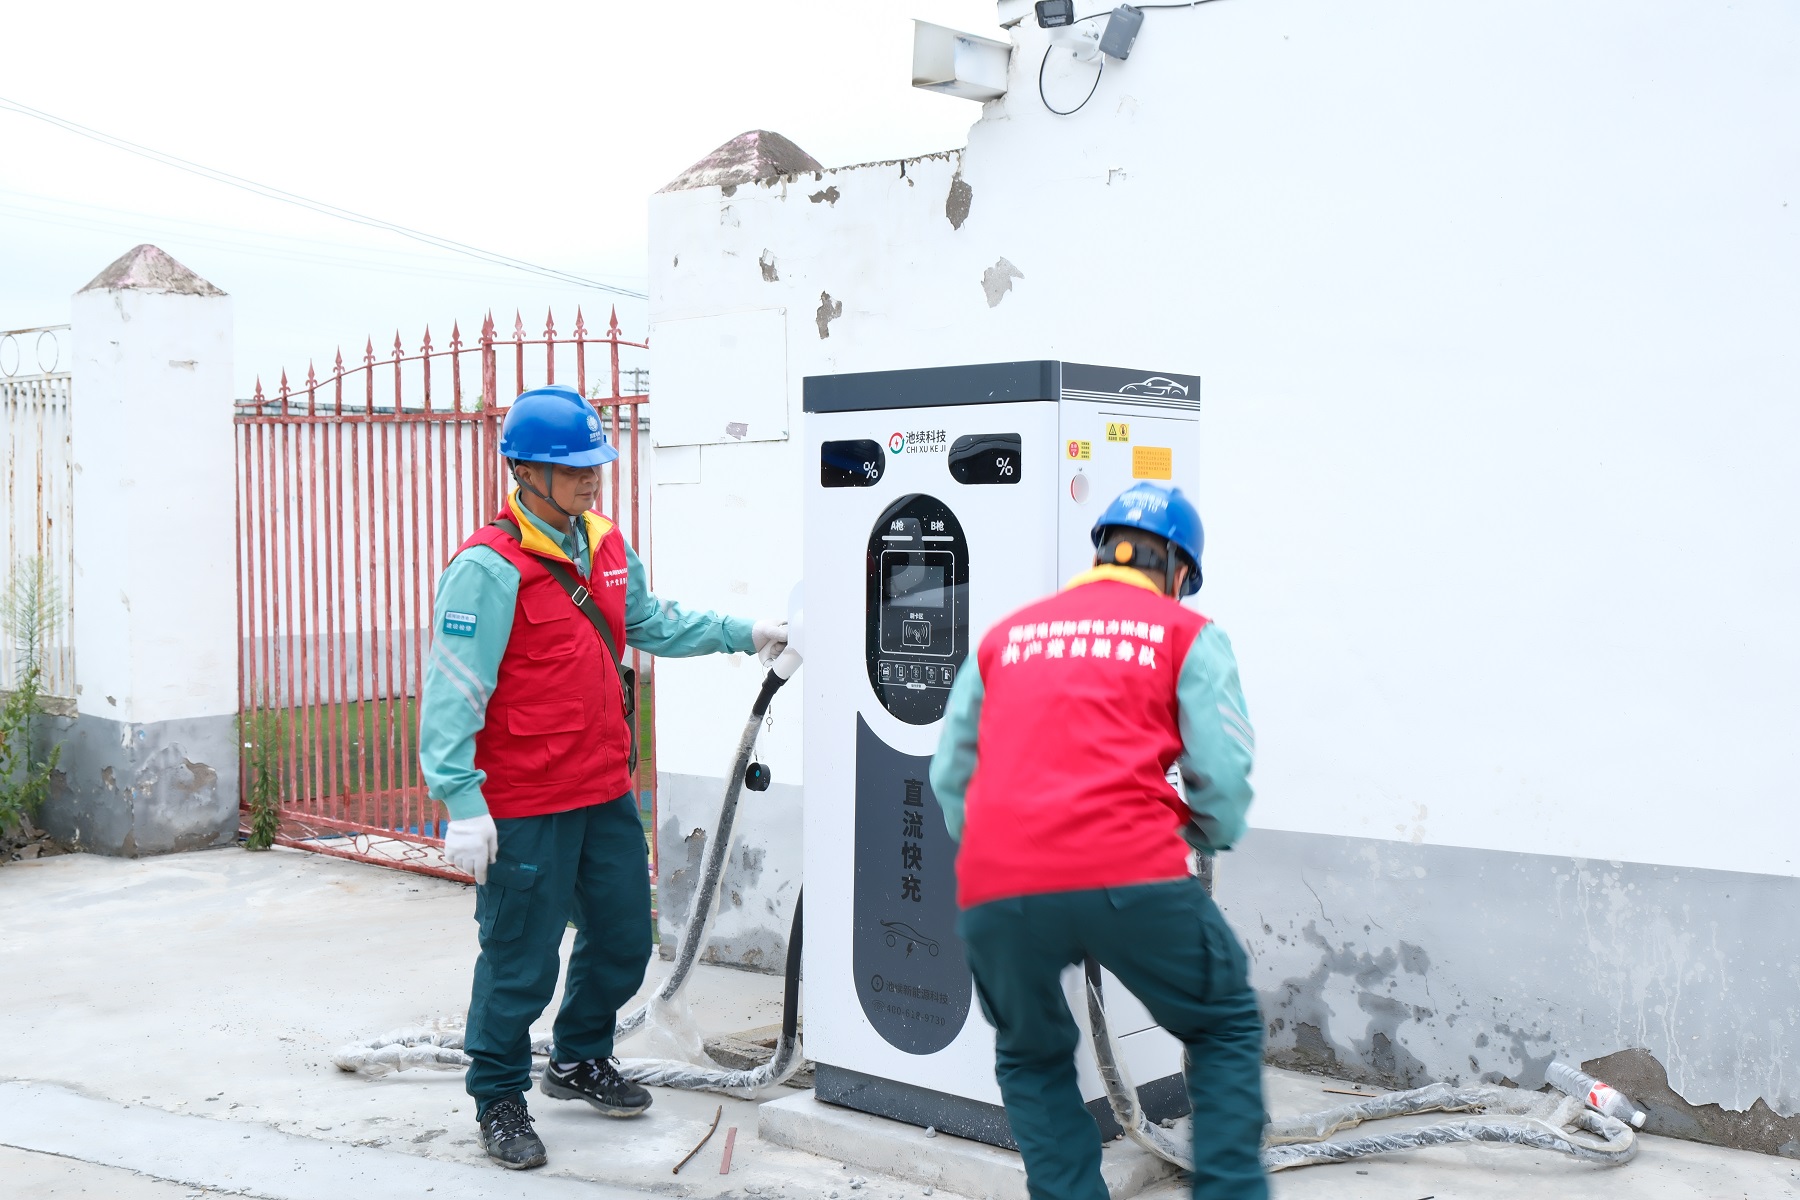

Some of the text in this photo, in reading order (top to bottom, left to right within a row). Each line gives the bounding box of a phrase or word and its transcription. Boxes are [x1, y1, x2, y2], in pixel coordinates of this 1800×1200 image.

[905, 429, 947, 444] 池续科技
[906, 444, 946, 454] CHI XU KE JI
[863, 461, 879, 479] %
[996, 457, 1013, 476] %
[890, 520, 904, 532] A枪
[930, 520, 945, 532] B枪
[901, 778, 924, 903] 直流快充
